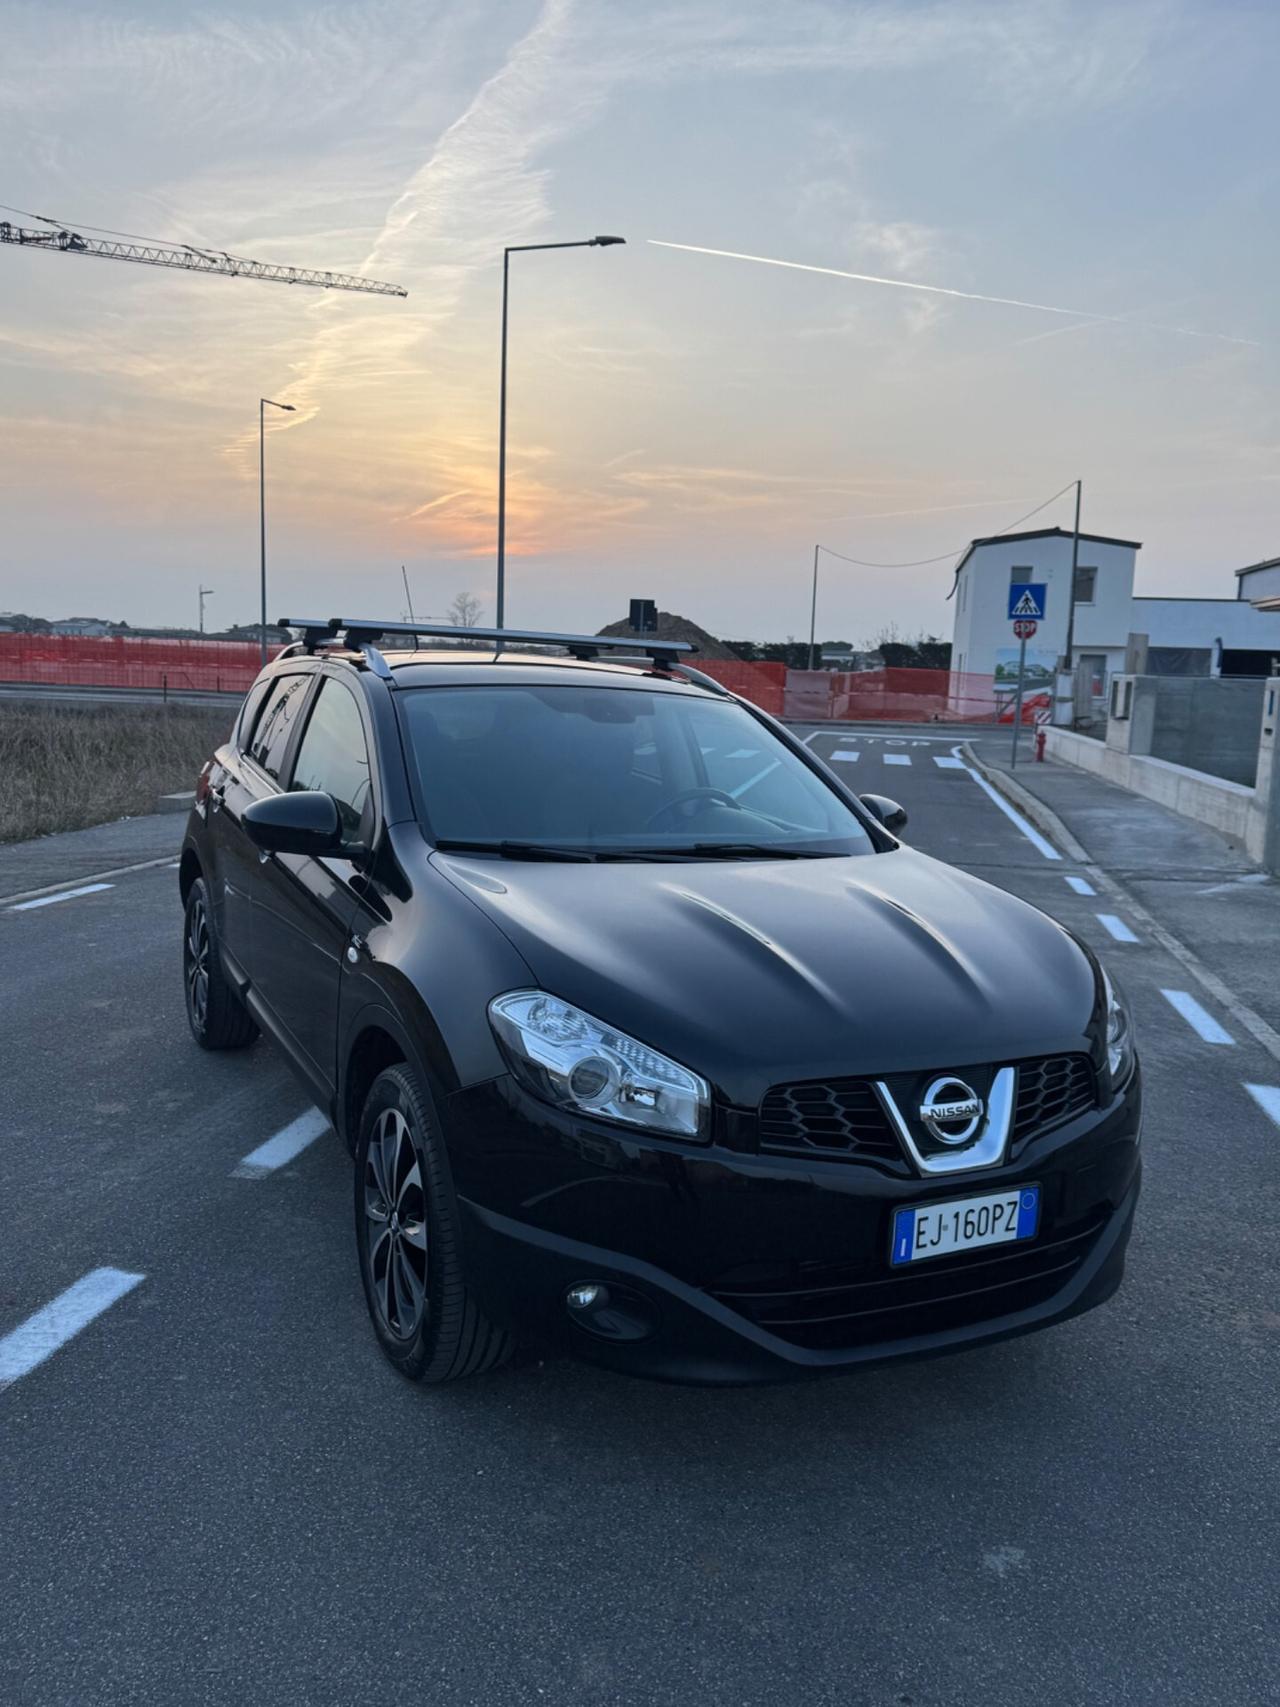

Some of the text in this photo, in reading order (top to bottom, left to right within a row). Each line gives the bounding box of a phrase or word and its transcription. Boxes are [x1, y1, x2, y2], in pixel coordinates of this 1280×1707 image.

[1014, 622, 1036, 633] STOP
[838, 737, 931, 747] STOP
[929, 1103, 980, 1118] NISSAN
